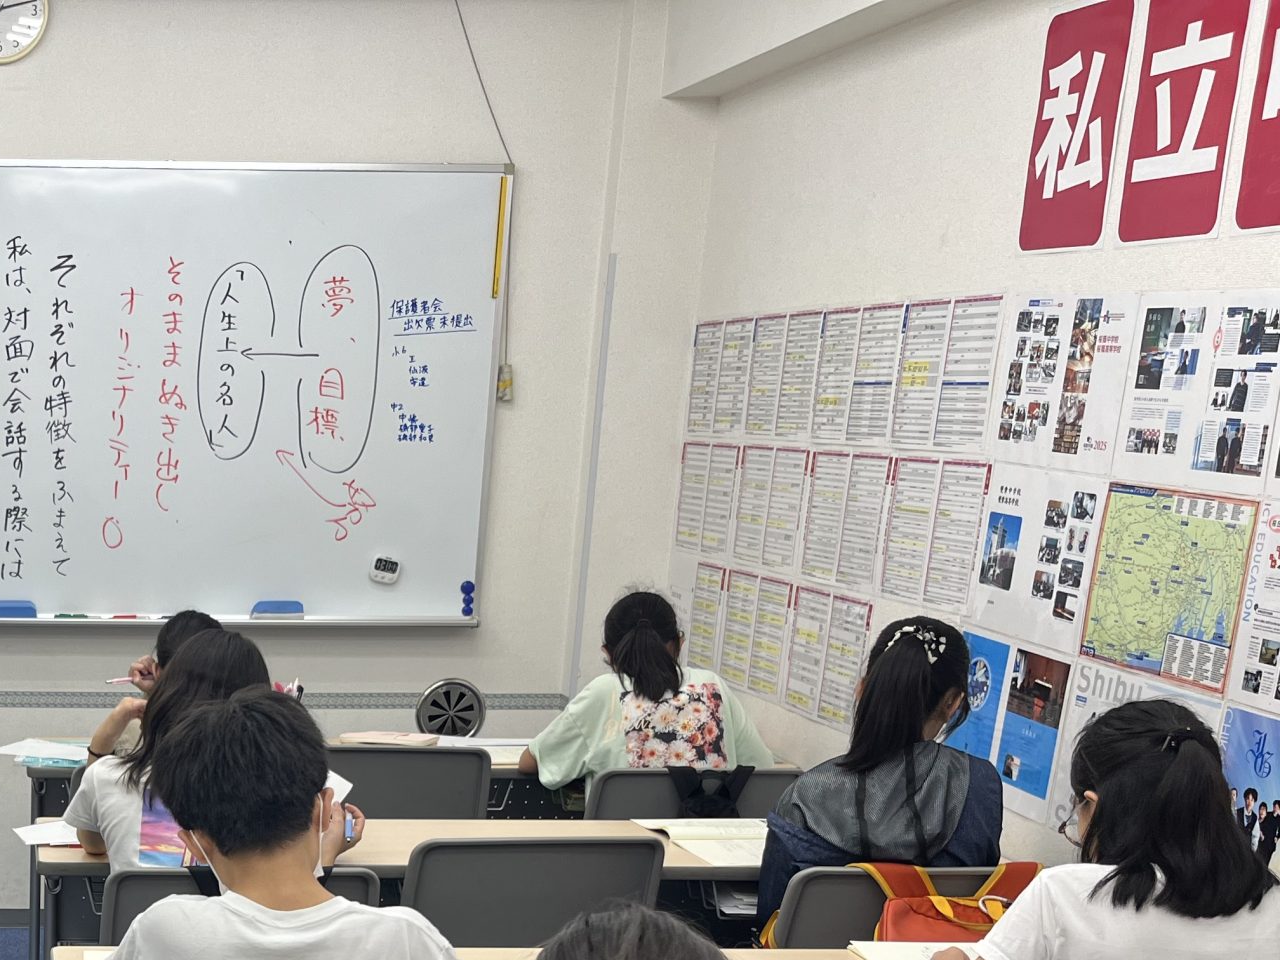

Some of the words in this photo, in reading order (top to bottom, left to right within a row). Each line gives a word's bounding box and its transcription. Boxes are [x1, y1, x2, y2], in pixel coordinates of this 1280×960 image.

[31, 5, 38, 16] 3
[1035, 20, 1280, 199] 私立
[1242, 532, 1266, 622] EDUCATION
